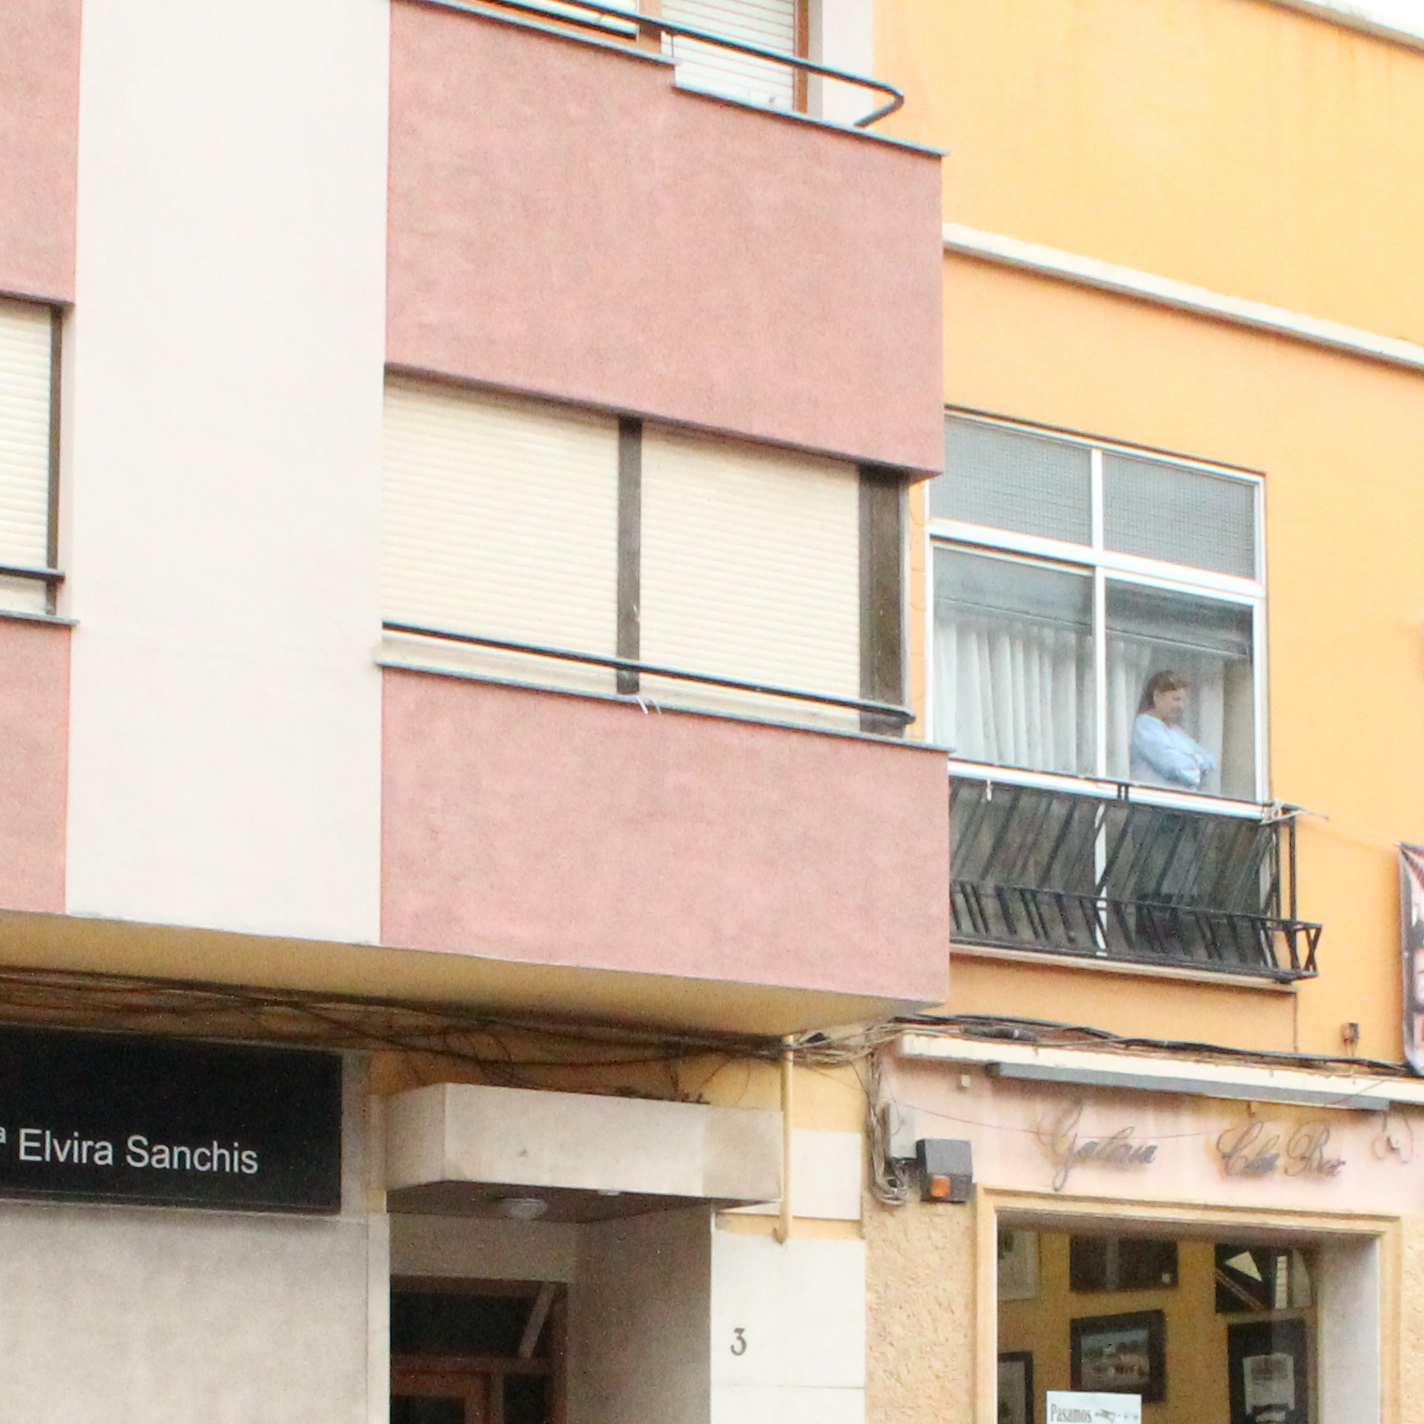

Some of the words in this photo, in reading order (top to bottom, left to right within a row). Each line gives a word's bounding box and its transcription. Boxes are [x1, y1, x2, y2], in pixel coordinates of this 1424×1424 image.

[19, 1128, 113, 1166] Elvira
[125, 1134, 258, 1175] Sanchis
[730, 1327, 747, 1357] 3
